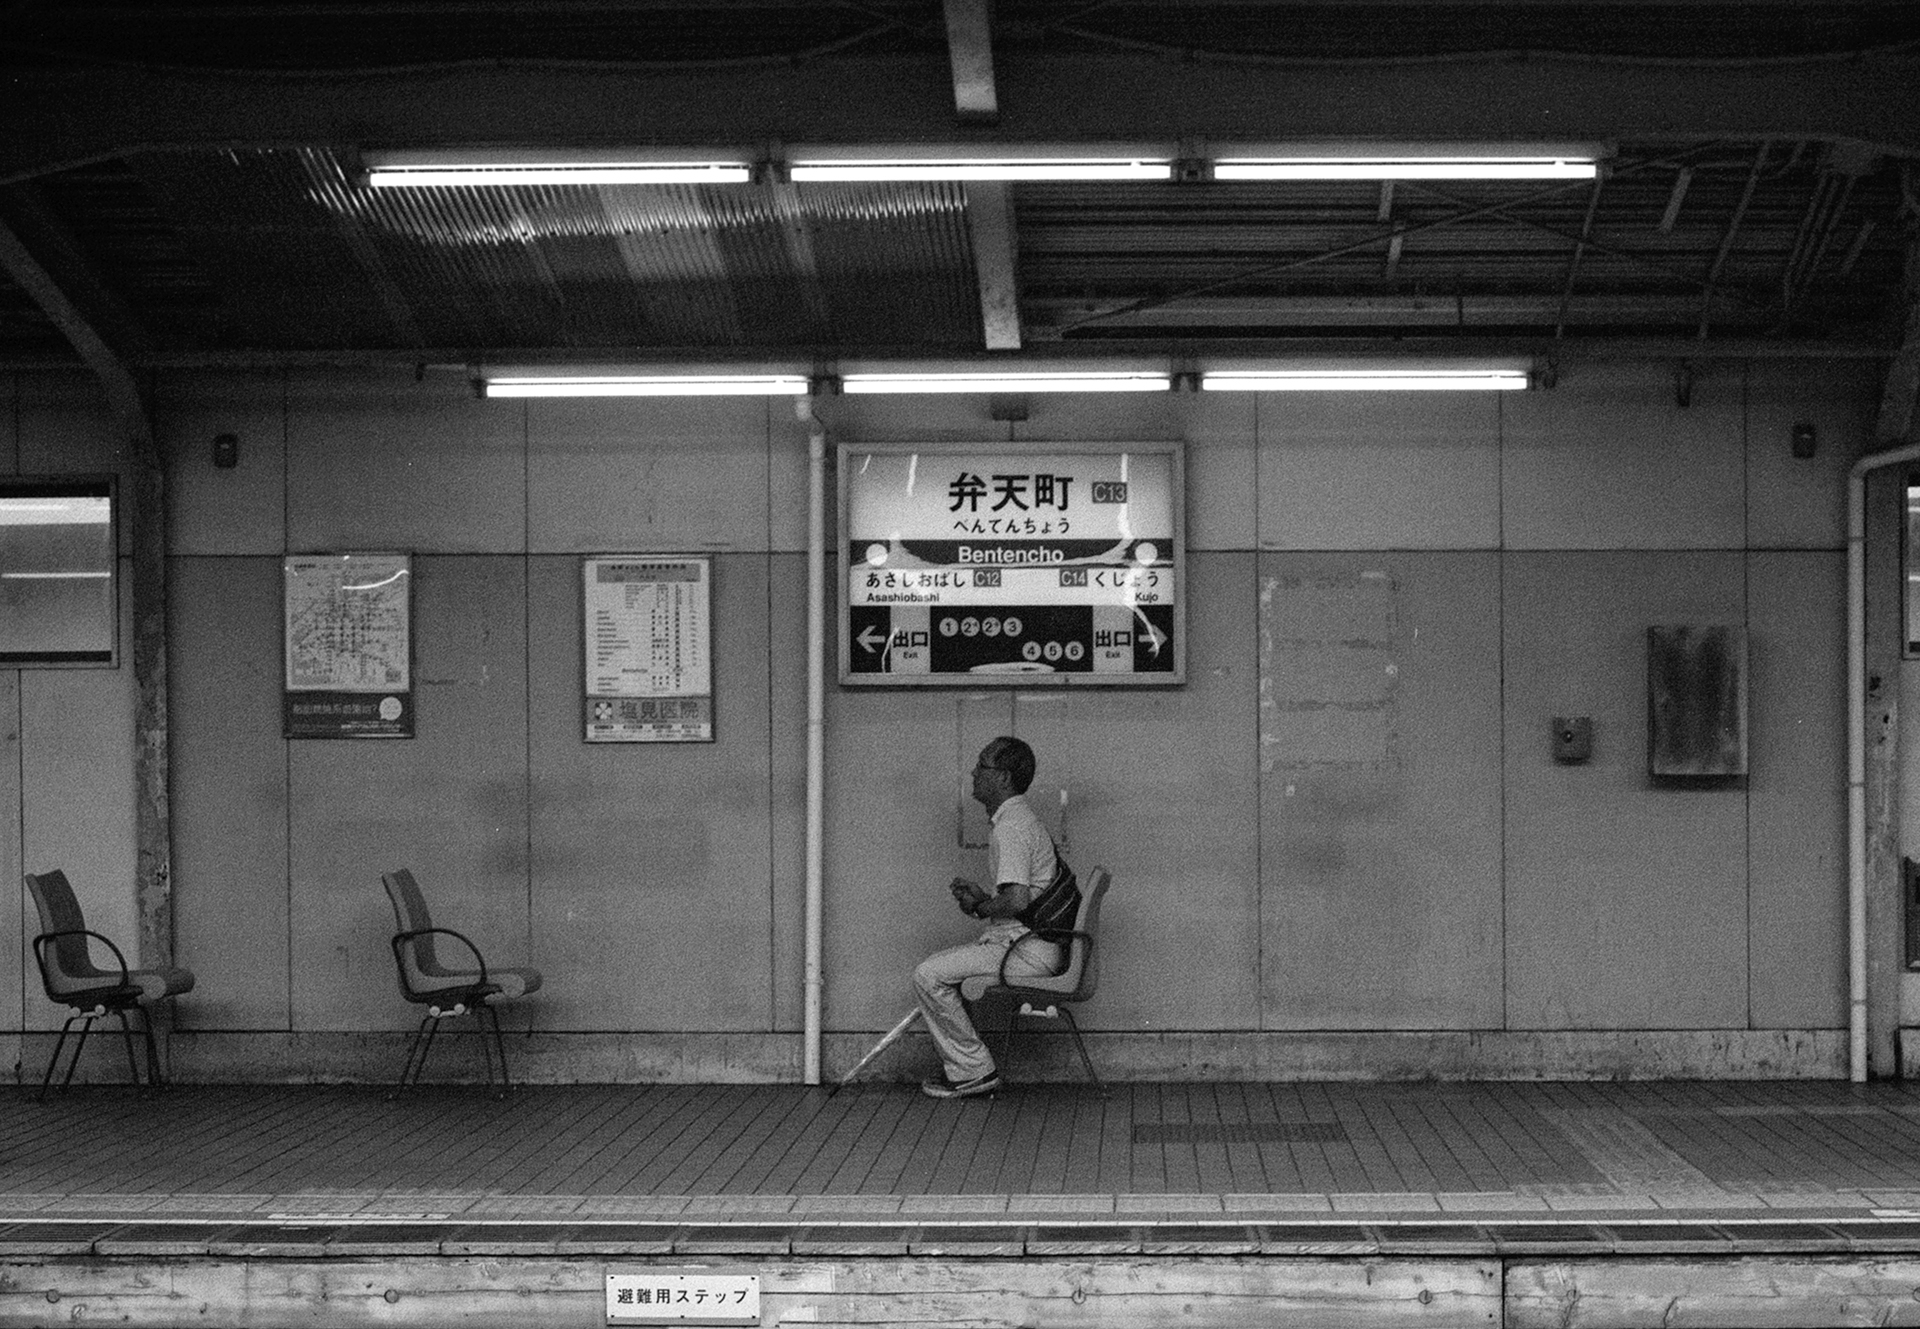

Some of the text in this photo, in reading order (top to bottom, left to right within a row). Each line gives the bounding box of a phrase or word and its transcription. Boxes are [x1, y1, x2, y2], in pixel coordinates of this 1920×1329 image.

[949, 472, 1127, 512] 弁天町 C13
[953, 517, 1071, 535] べんてんちょう
[957, 545, 1064, 563] Bentencho
[866, 571, 1001, 588] あさしおばし C12
[1060, 571, 1087, 586] C14
[866, 592, 940, 603] Asashiobashi
[1134, 592, 1159, 604] Kujo
[892, 631, 928, 648] 出口
[1095, 630, 1131, 648] 出口
[617, 1287, 750, 1304] 避難用ステップ
